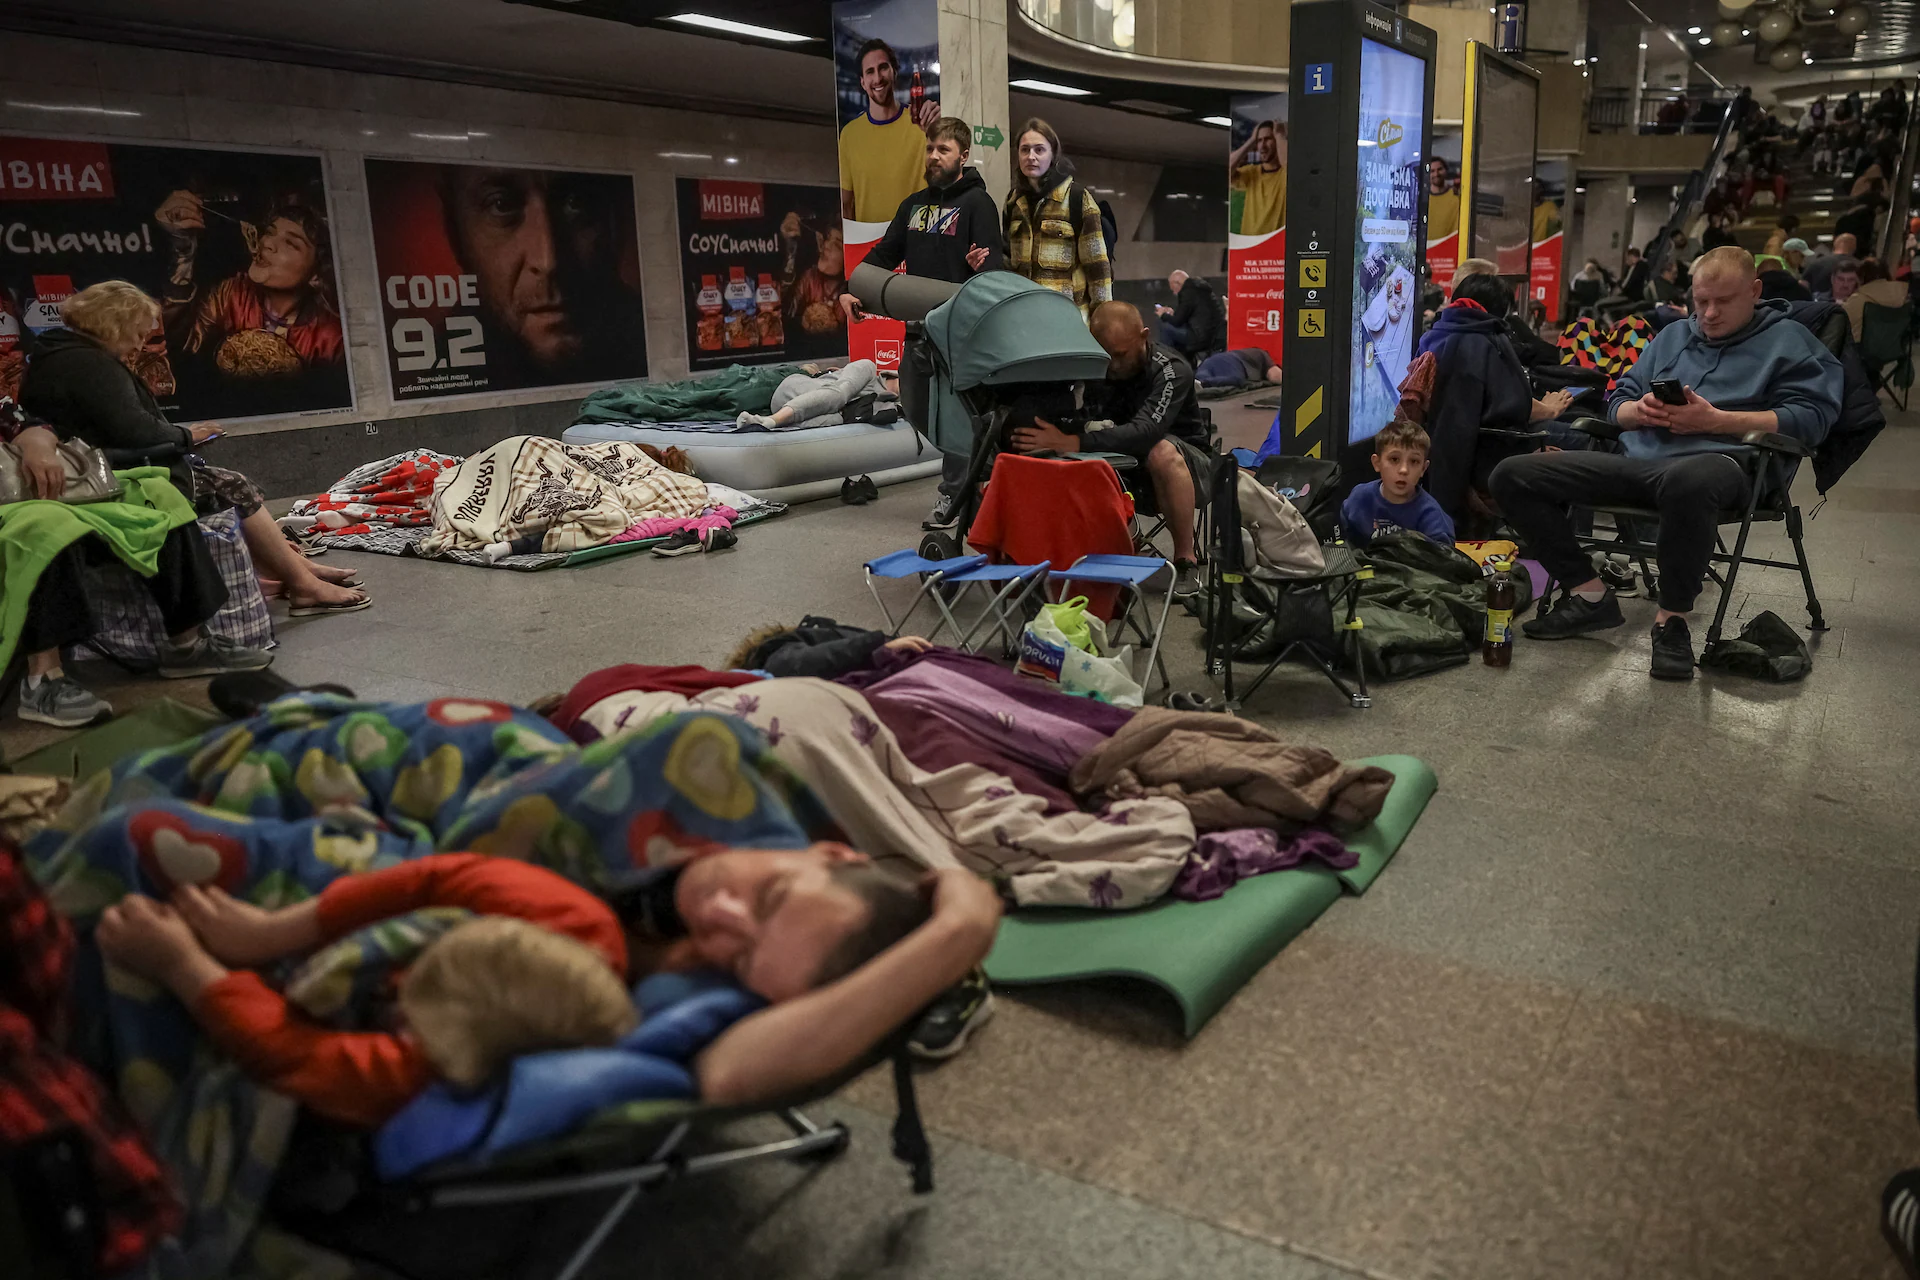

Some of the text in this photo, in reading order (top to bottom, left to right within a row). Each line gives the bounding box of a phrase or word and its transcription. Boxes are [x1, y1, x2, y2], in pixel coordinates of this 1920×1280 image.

[0, 160, 102, 193] ІВІНА
[1365, 161, 1411, 187] ЗАМІСЬКА
[702, 193, 760, 215] МІВІНА
[1364, 187, 1411, 210] ДОСТАВКА
[0, 222, 154, 254] Смачно!
[385, 274, 480, 309] CODE
[391, 315, 487, 372] 9.2
[399, 377, 489, 394] роблять надзвичайні речі
[416, 373, 470, 384] Звичайні люди
[366, 423, 377, 434] 20
